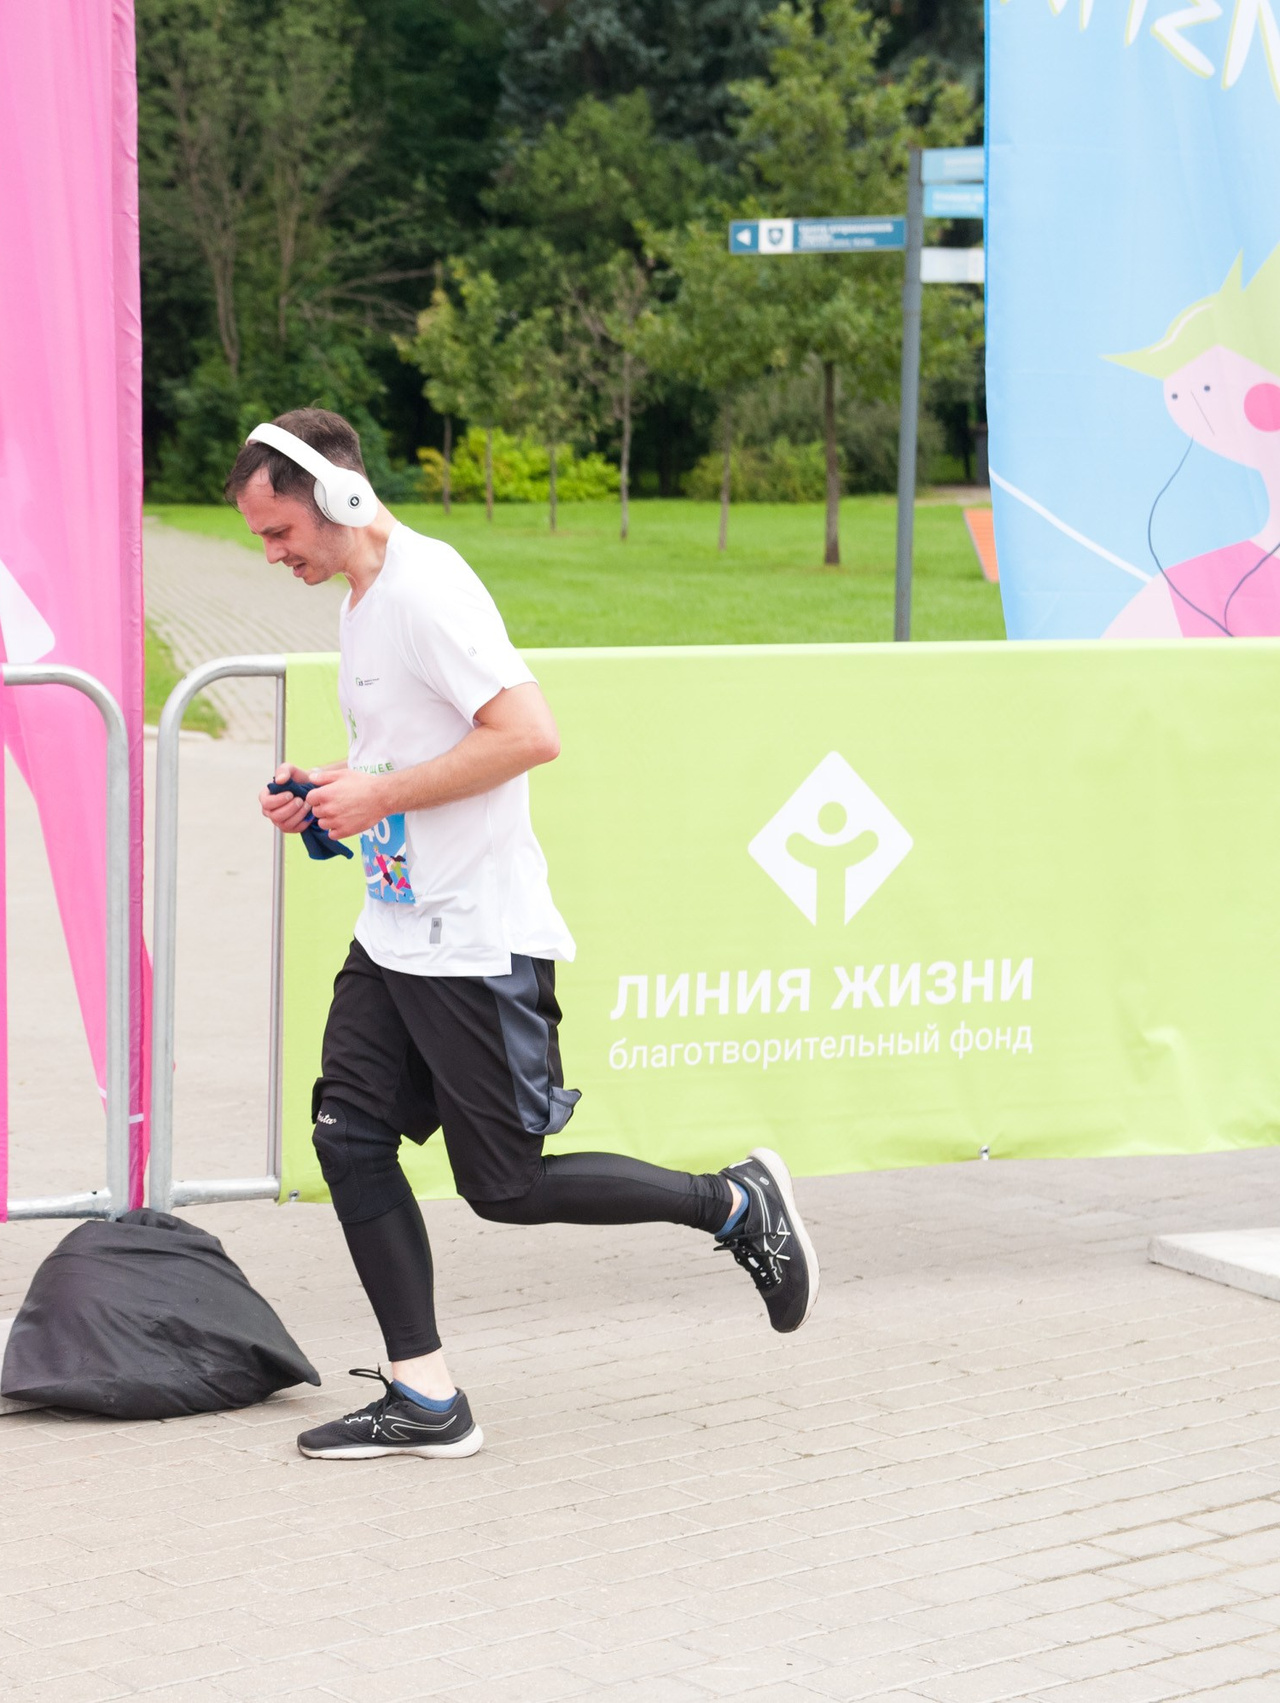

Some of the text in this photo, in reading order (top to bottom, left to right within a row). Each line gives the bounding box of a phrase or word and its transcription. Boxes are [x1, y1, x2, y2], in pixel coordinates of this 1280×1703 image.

[610, 957, 1034, 1020] ЛИНИЯ ЖИЗНИ
[608, 1020, 1033, 1070] благотворительный фонд
